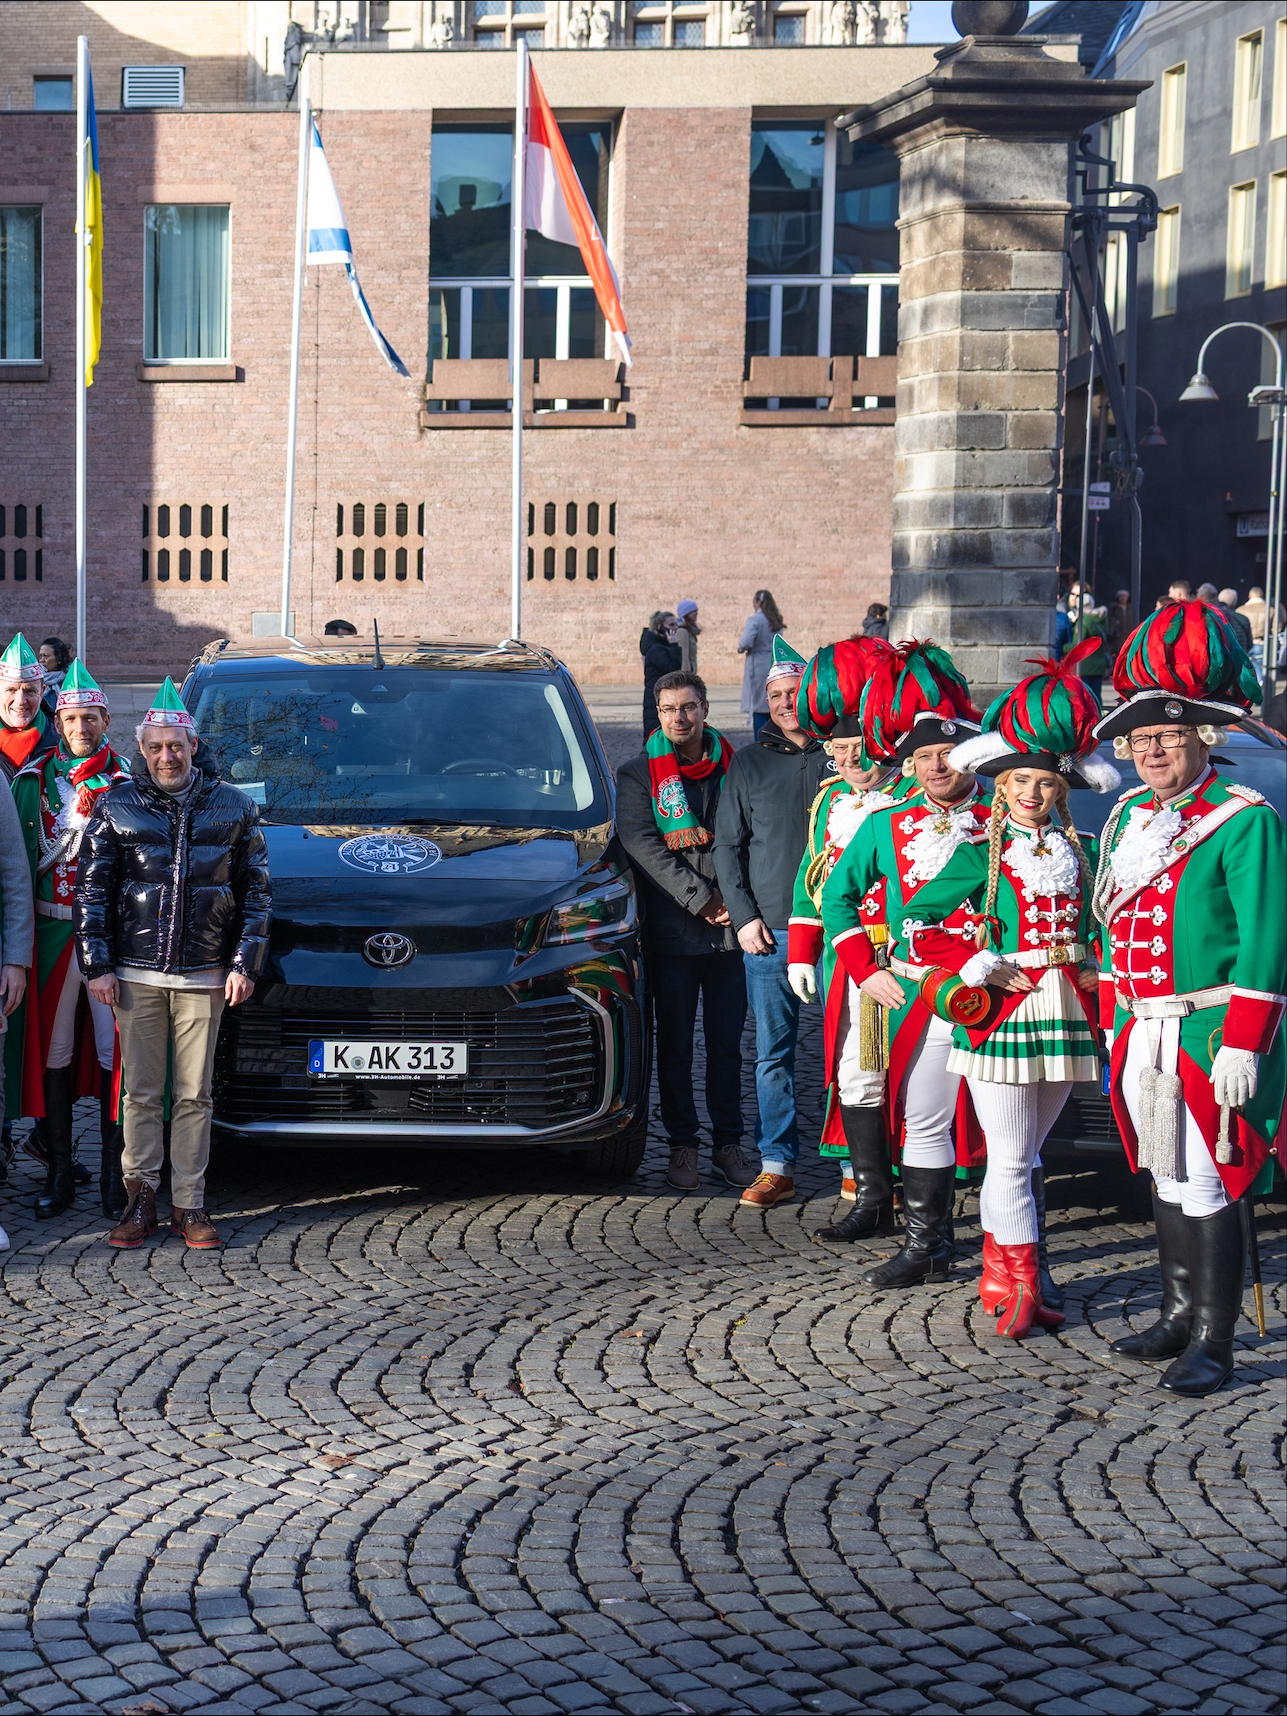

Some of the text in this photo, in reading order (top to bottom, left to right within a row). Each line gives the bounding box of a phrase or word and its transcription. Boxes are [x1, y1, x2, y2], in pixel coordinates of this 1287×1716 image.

[314, 1060, 321, 1068] D
[334, 1045, 455, 1070] K AK 313
